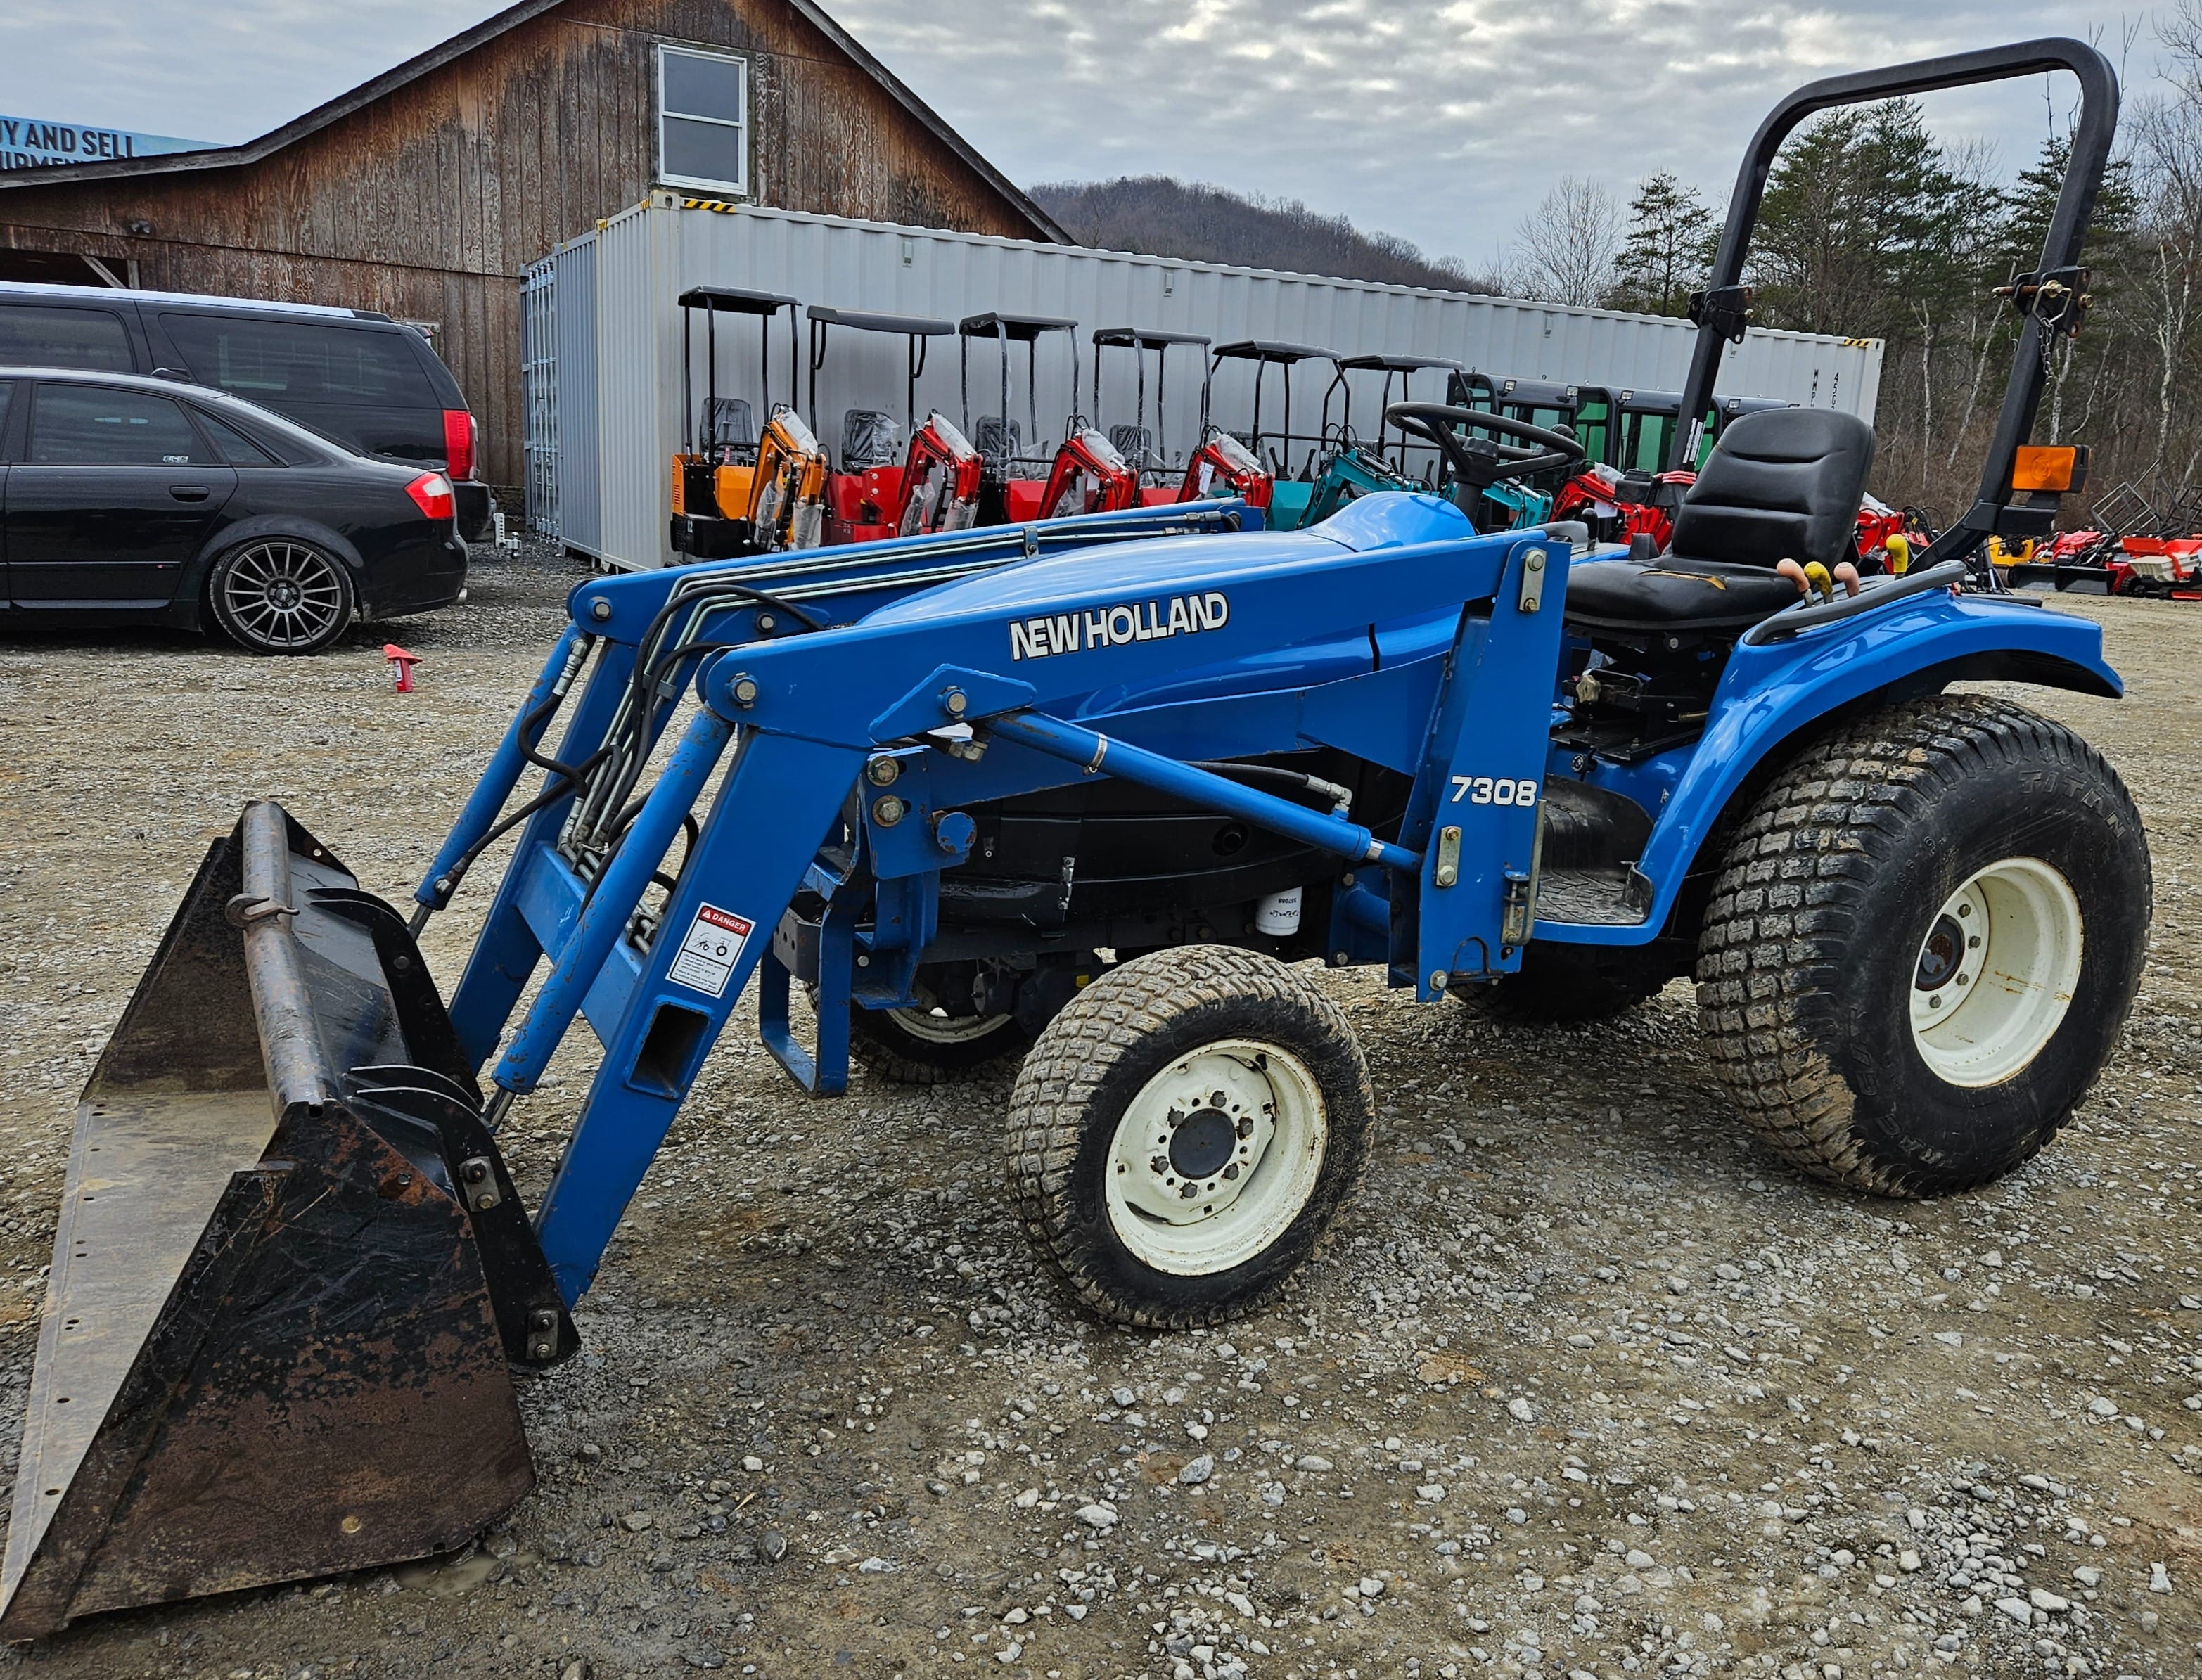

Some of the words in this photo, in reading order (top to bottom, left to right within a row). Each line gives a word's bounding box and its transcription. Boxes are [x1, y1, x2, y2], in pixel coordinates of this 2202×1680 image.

[0, 119, 19, 146] Y
[25, 123, 76, 153] AND
[82, 130, 132, 159] SELL
[1830, 371, 1839, 409] 45G
[1009, 613, 1080, 661] NEW
[1084, 591, 1229, 650] HOLLAND
[1450, 775, 1538, 807] 7308
[2019, 769, 2127, 839] TITAN
[712, 913, 746, 932] DANGER
